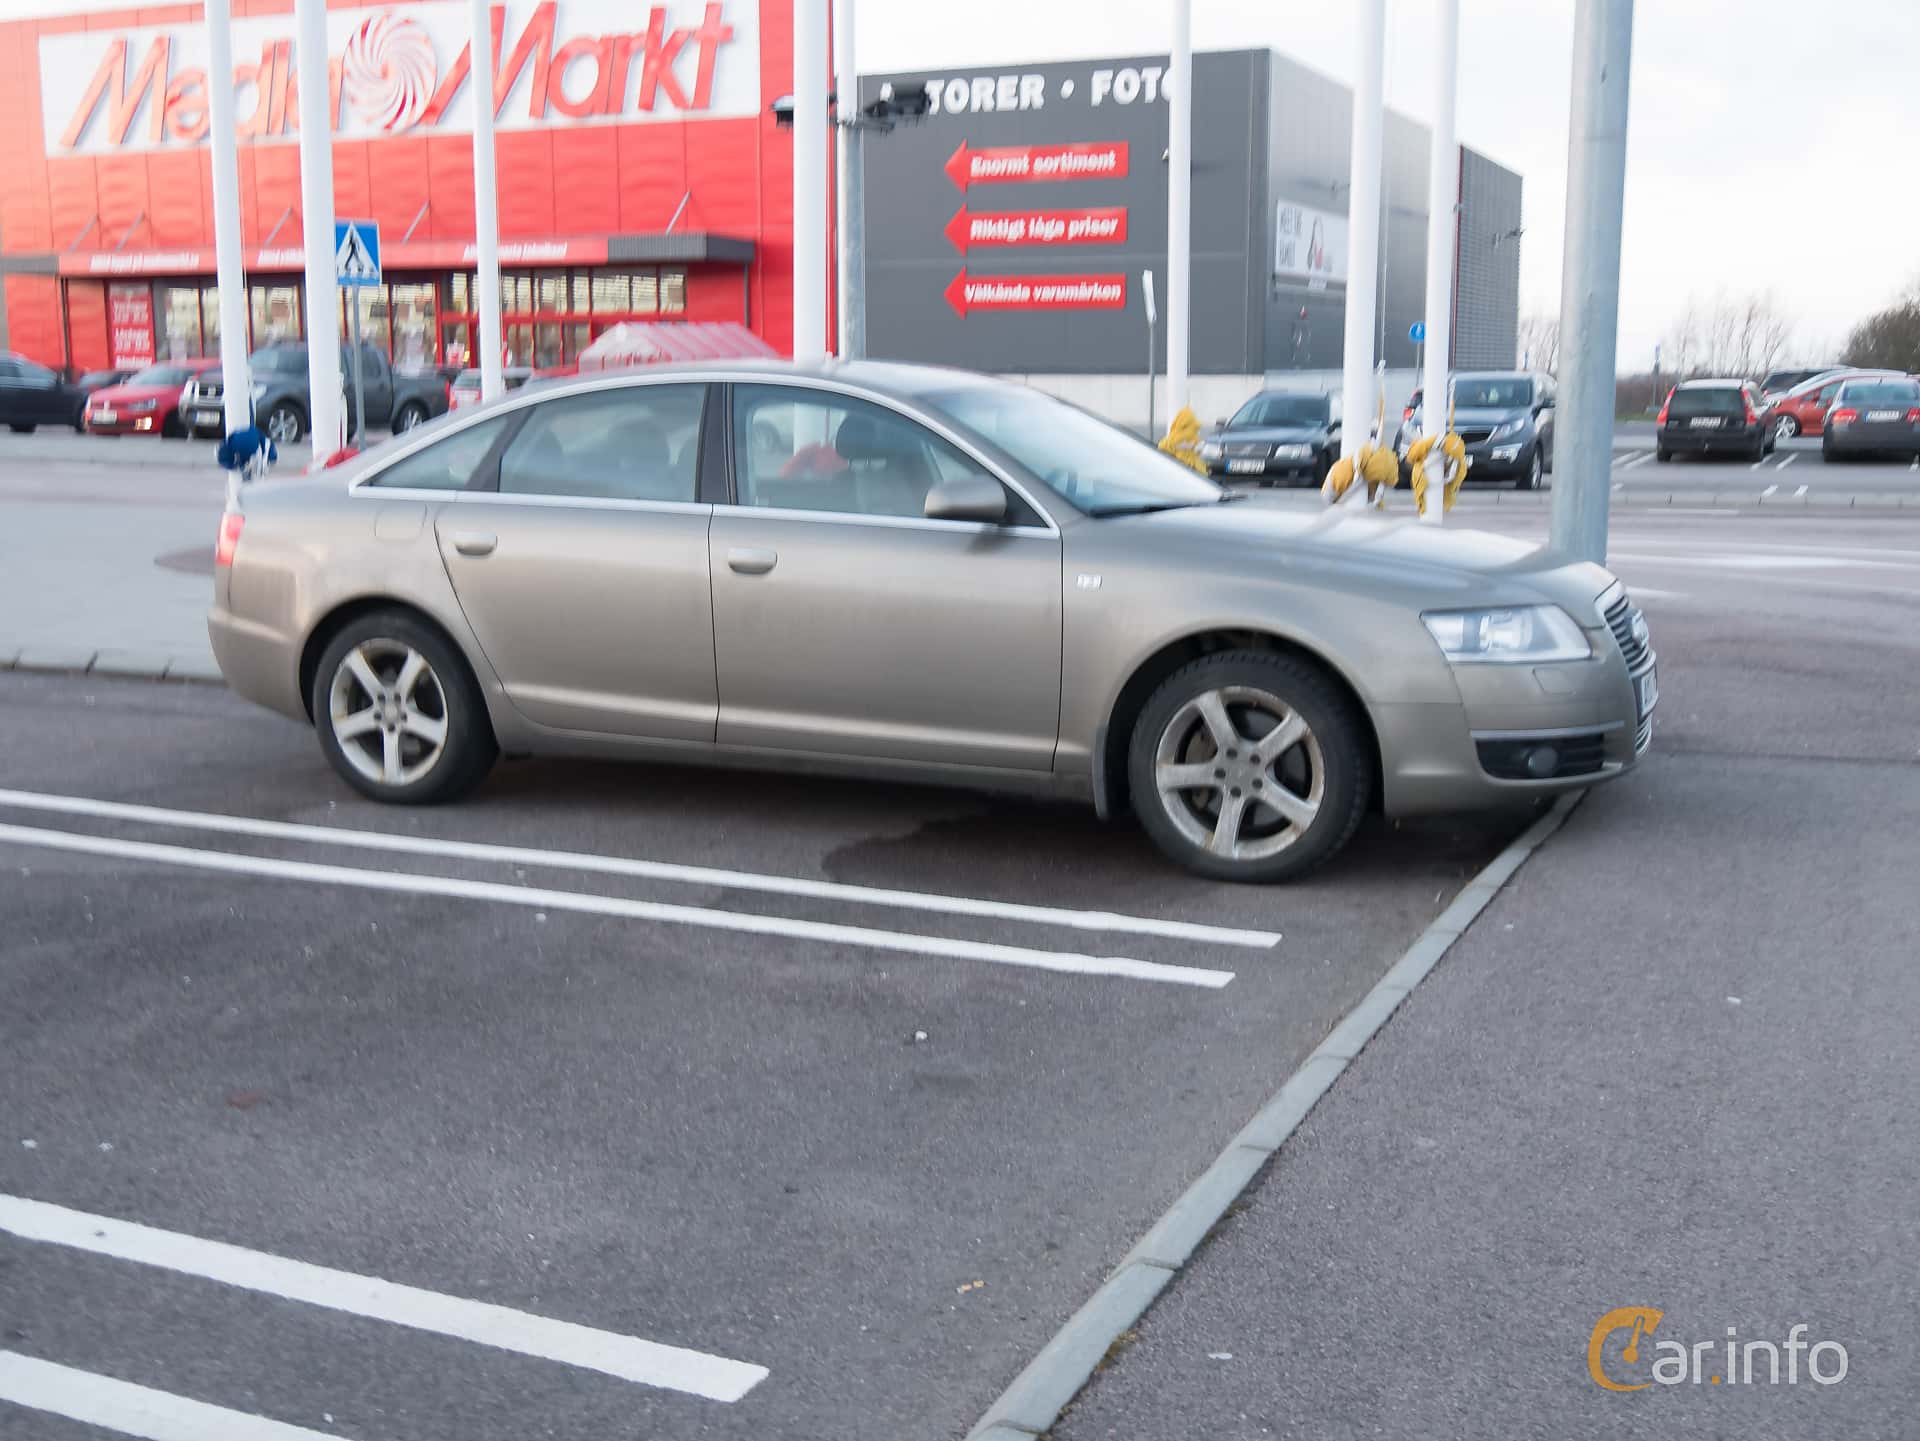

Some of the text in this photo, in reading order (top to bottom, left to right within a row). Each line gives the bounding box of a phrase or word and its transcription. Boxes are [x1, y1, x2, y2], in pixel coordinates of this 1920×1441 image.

[417, 0, 734, 126] Markt
[970, 149, 1116, 177] Enormt sortiment
[970, 218, 1025, 242] Riktigt
[1067, 215, 1118, 240] priser
